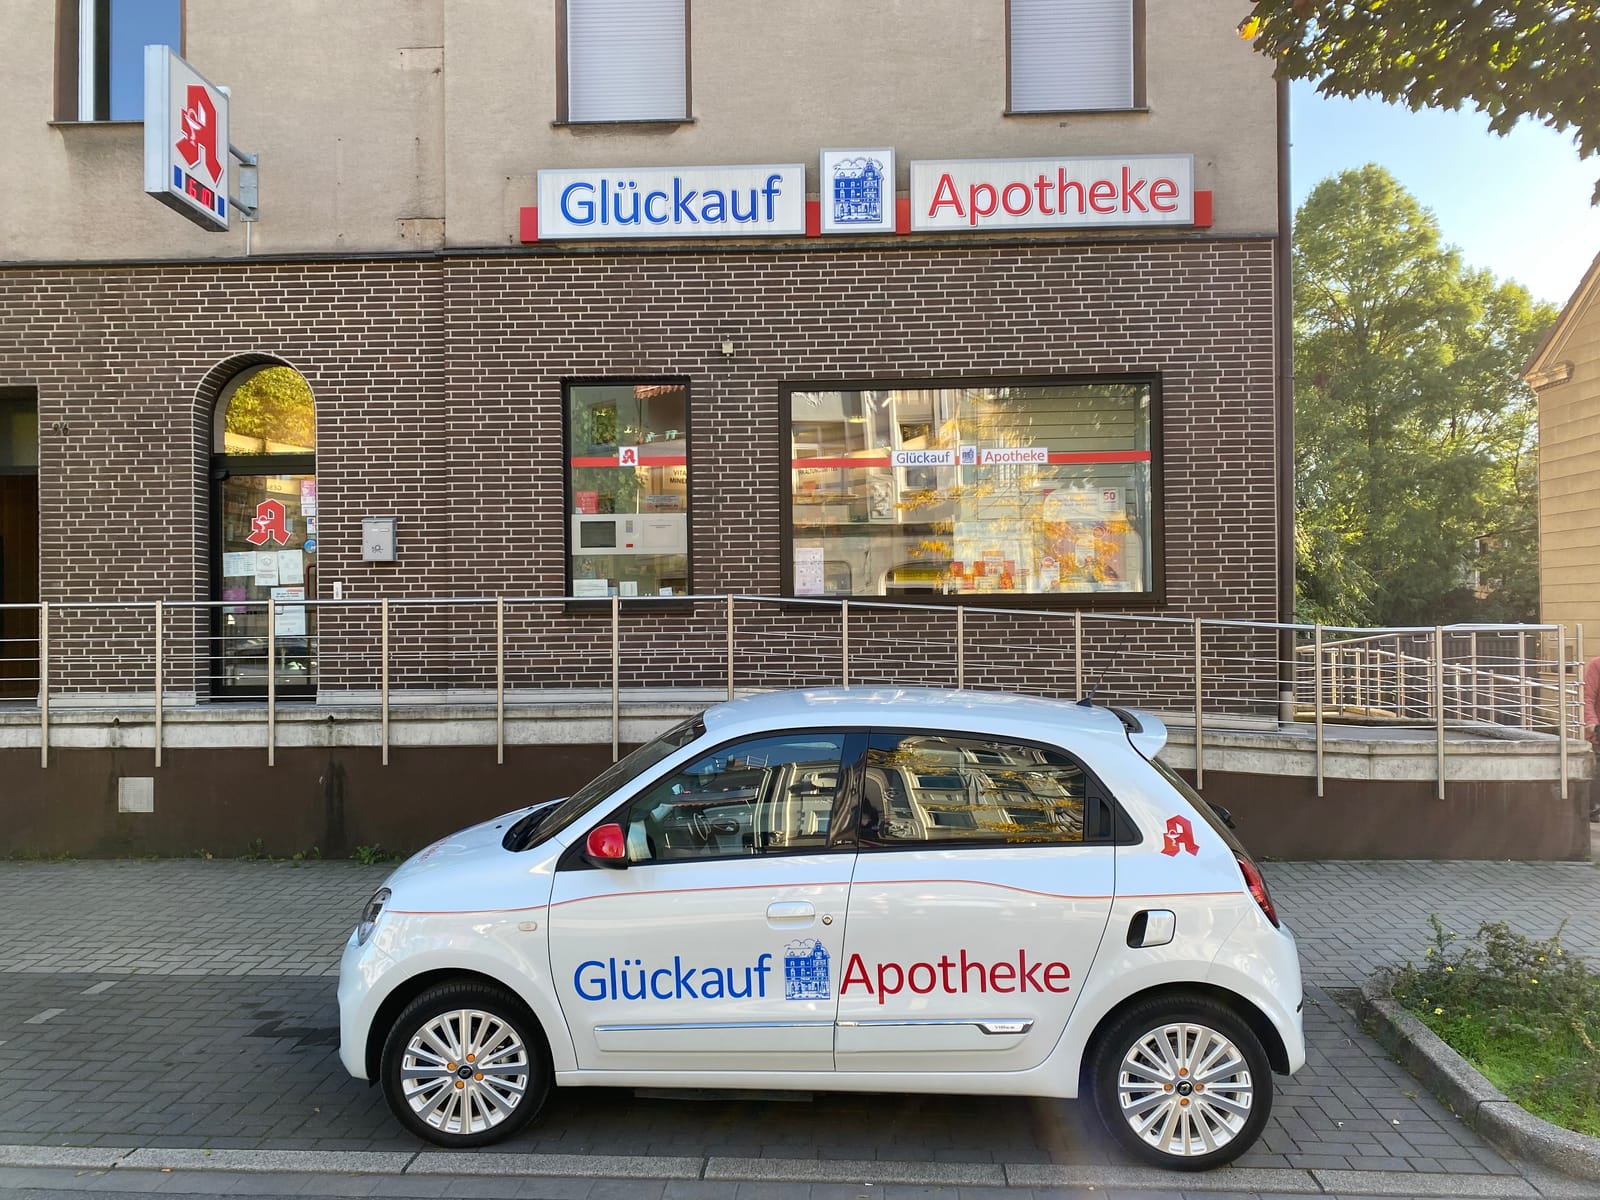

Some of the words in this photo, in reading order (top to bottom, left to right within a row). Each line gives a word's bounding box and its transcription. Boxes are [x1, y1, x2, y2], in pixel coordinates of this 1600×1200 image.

[560, 174, 783, 226] Glückauf
[928, 165, 1180, 227] Apotheke
[896, 451, 950, 464] Glückauf
[984, 449, 1045, 465] Apotheke
[573, 953, 773, 1001] Glückauf
[840, 949, 1071, 1005] Apotheke
